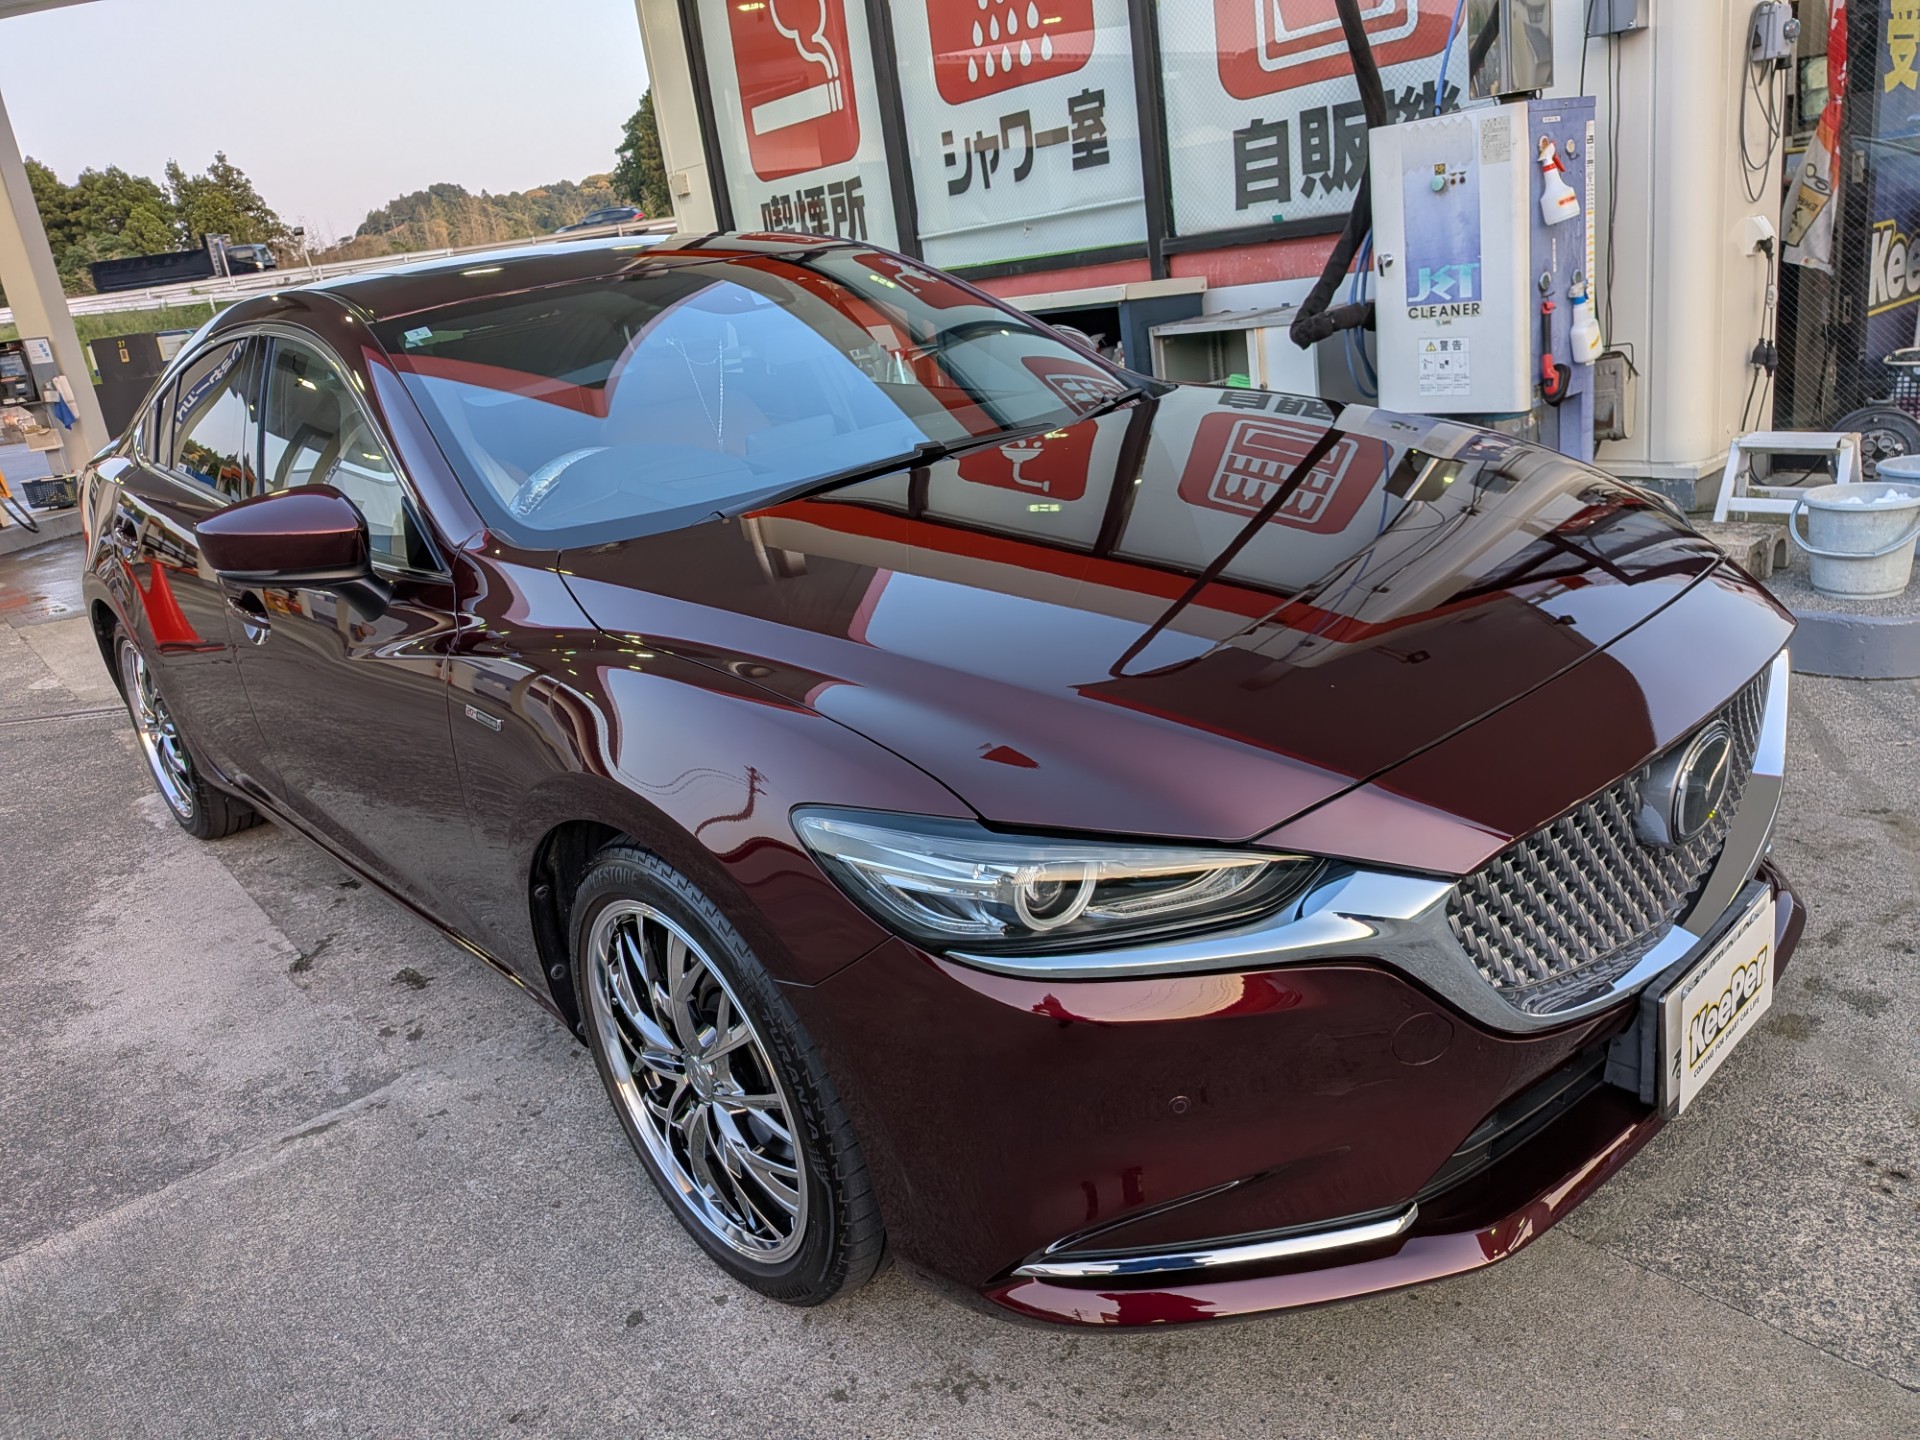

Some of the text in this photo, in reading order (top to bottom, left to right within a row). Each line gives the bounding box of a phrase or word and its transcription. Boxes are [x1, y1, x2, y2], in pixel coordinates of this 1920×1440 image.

[941, 88, 1110, 196] シャワー室
[760, 176, 868, 241] 喫煙所
[1407, 302, 1480, 319] CLEANER
[1690, 944, 1768, 1068] KeePer
[1714, 1037, 1725, 1053] FOR
[1740, 1007, 1749, 1022] CAR
